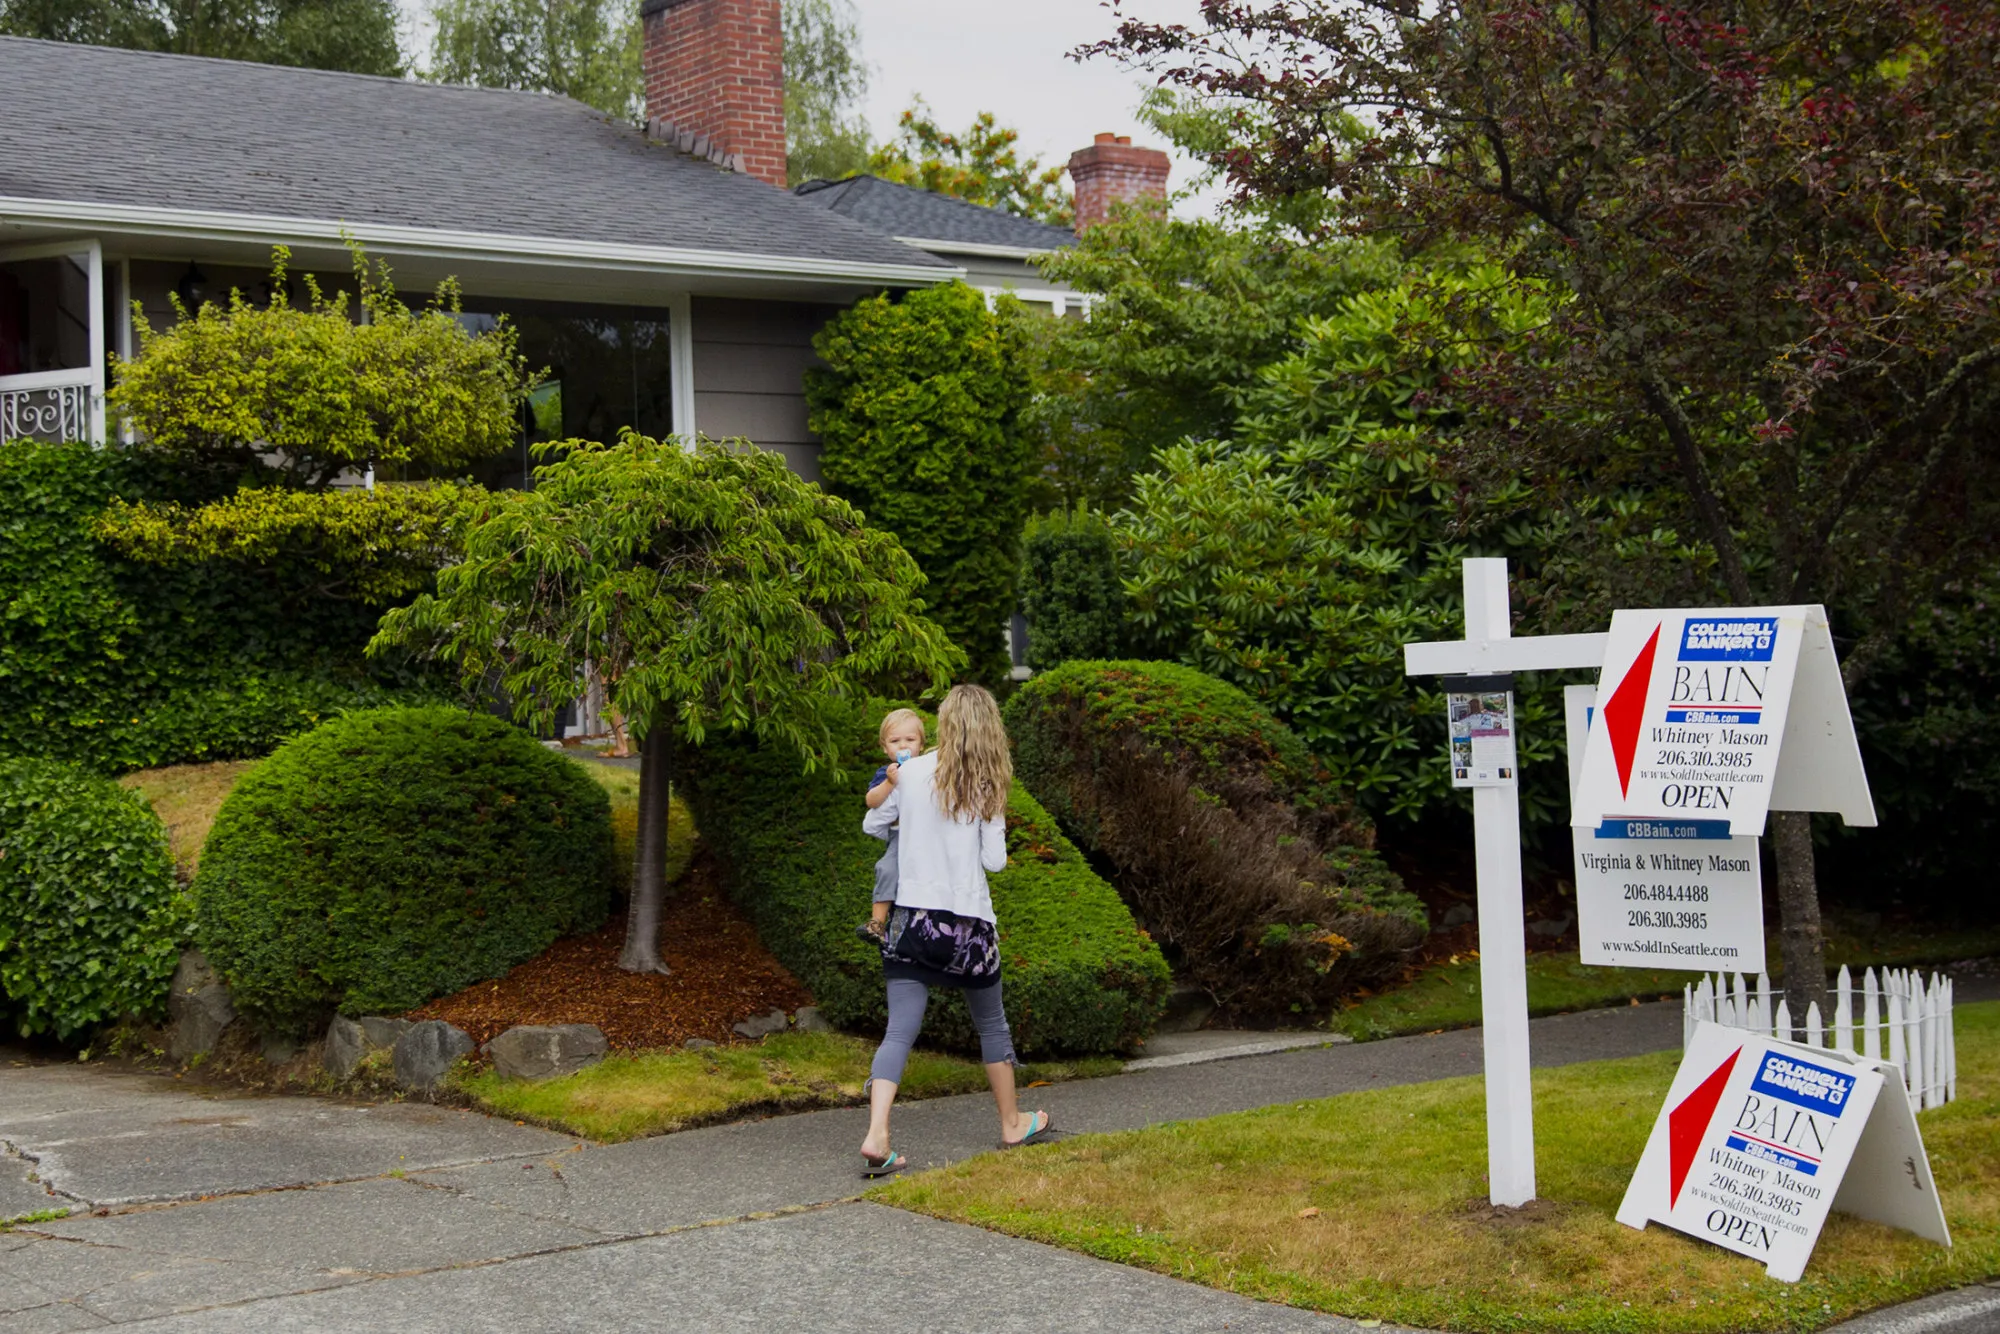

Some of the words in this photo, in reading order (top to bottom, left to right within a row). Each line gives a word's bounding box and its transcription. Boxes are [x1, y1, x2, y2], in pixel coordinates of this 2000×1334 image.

[1670, 666, 1770, 702] BAIN
[1685, 711, 1740, 724] CBBain.com
[1652, 727, 1714, 748] Whitney
[1719, 728, 1768, 745] Mason
[1657, 749, 1753, 767] 206.310.3985
[1640, 768, 1764, 783] www.SoldInSeattle.com
[1661, 784, 1734, 810] OPEN
[1626, 822, 1697, 838] CBBain.com
[1581, 853, 1631, 873] Virginia
[1635, 854, 1646, 870] &
[1650, 854, 1704, 876] Whitney
[1708, 854, 1751, 872] Mason
[1623, 883, 1709, 902] 206.484.4488
[1628, 910, 1707, 929] 206.310.3985
[1602, 940, 1738, 957] www.SoldInSeattle.com
[1734, 1094, 1838, 1154] BAIN
[1745, 1142, 1798, 1169] CBBain.com
[1709, 1147, 1769, 1184] Whitney
[1773, 1171, 1821, 1200] Mason
[1709, 1172, 1803, 1216] 206.310.3985
[1691, 1186, 1809, 1236] www.SoldInSeattle.com
[1706, 1209, 1778, 1252] OPEN
